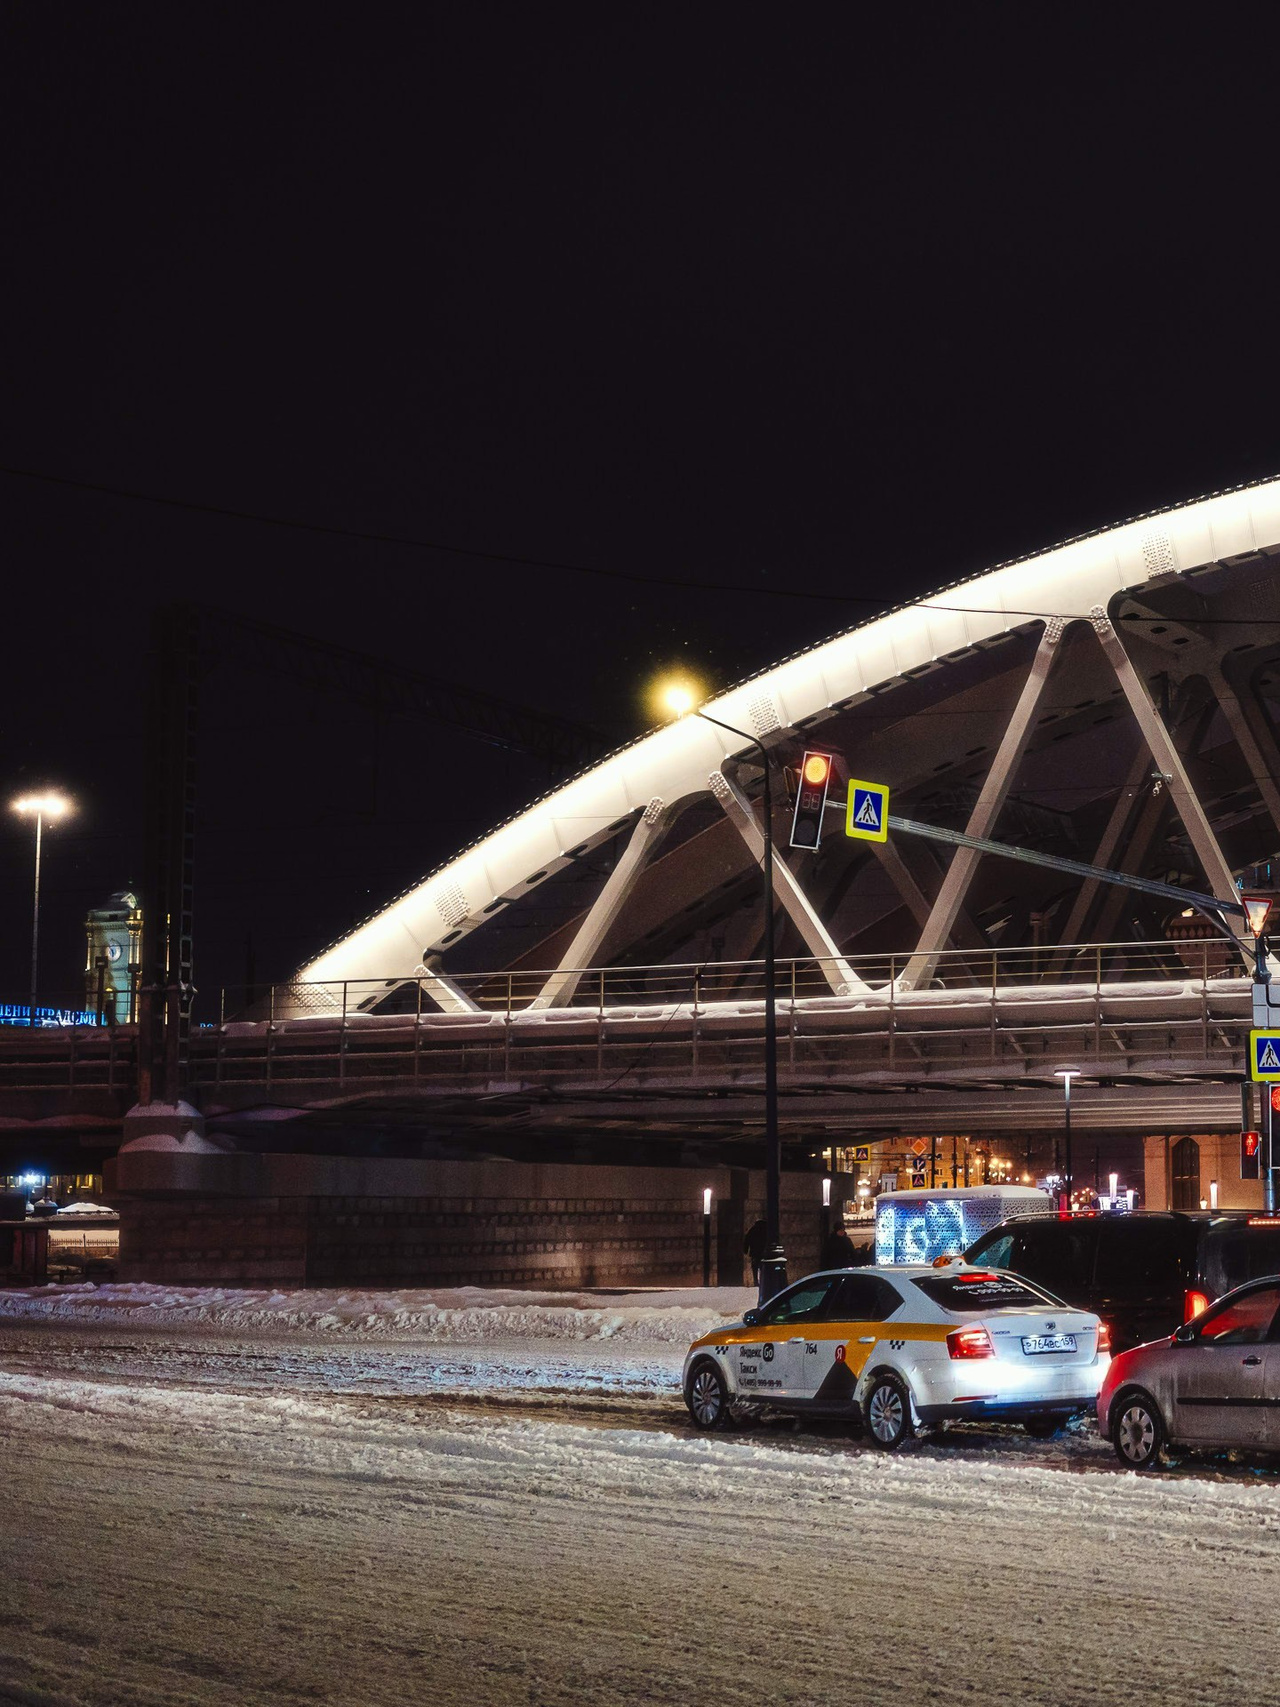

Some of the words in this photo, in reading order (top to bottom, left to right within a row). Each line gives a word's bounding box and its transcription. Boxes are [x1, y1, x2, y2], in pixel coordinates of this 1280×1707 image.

[739, 1345, 761, 1359] Яндекс
[763, 1346, 773, 1359] Go
[805, 1343, 818, 1355] 764
[740, 1362, 758, 1374] Такси
[758, 1379, 782, 1388] 999-99-99
